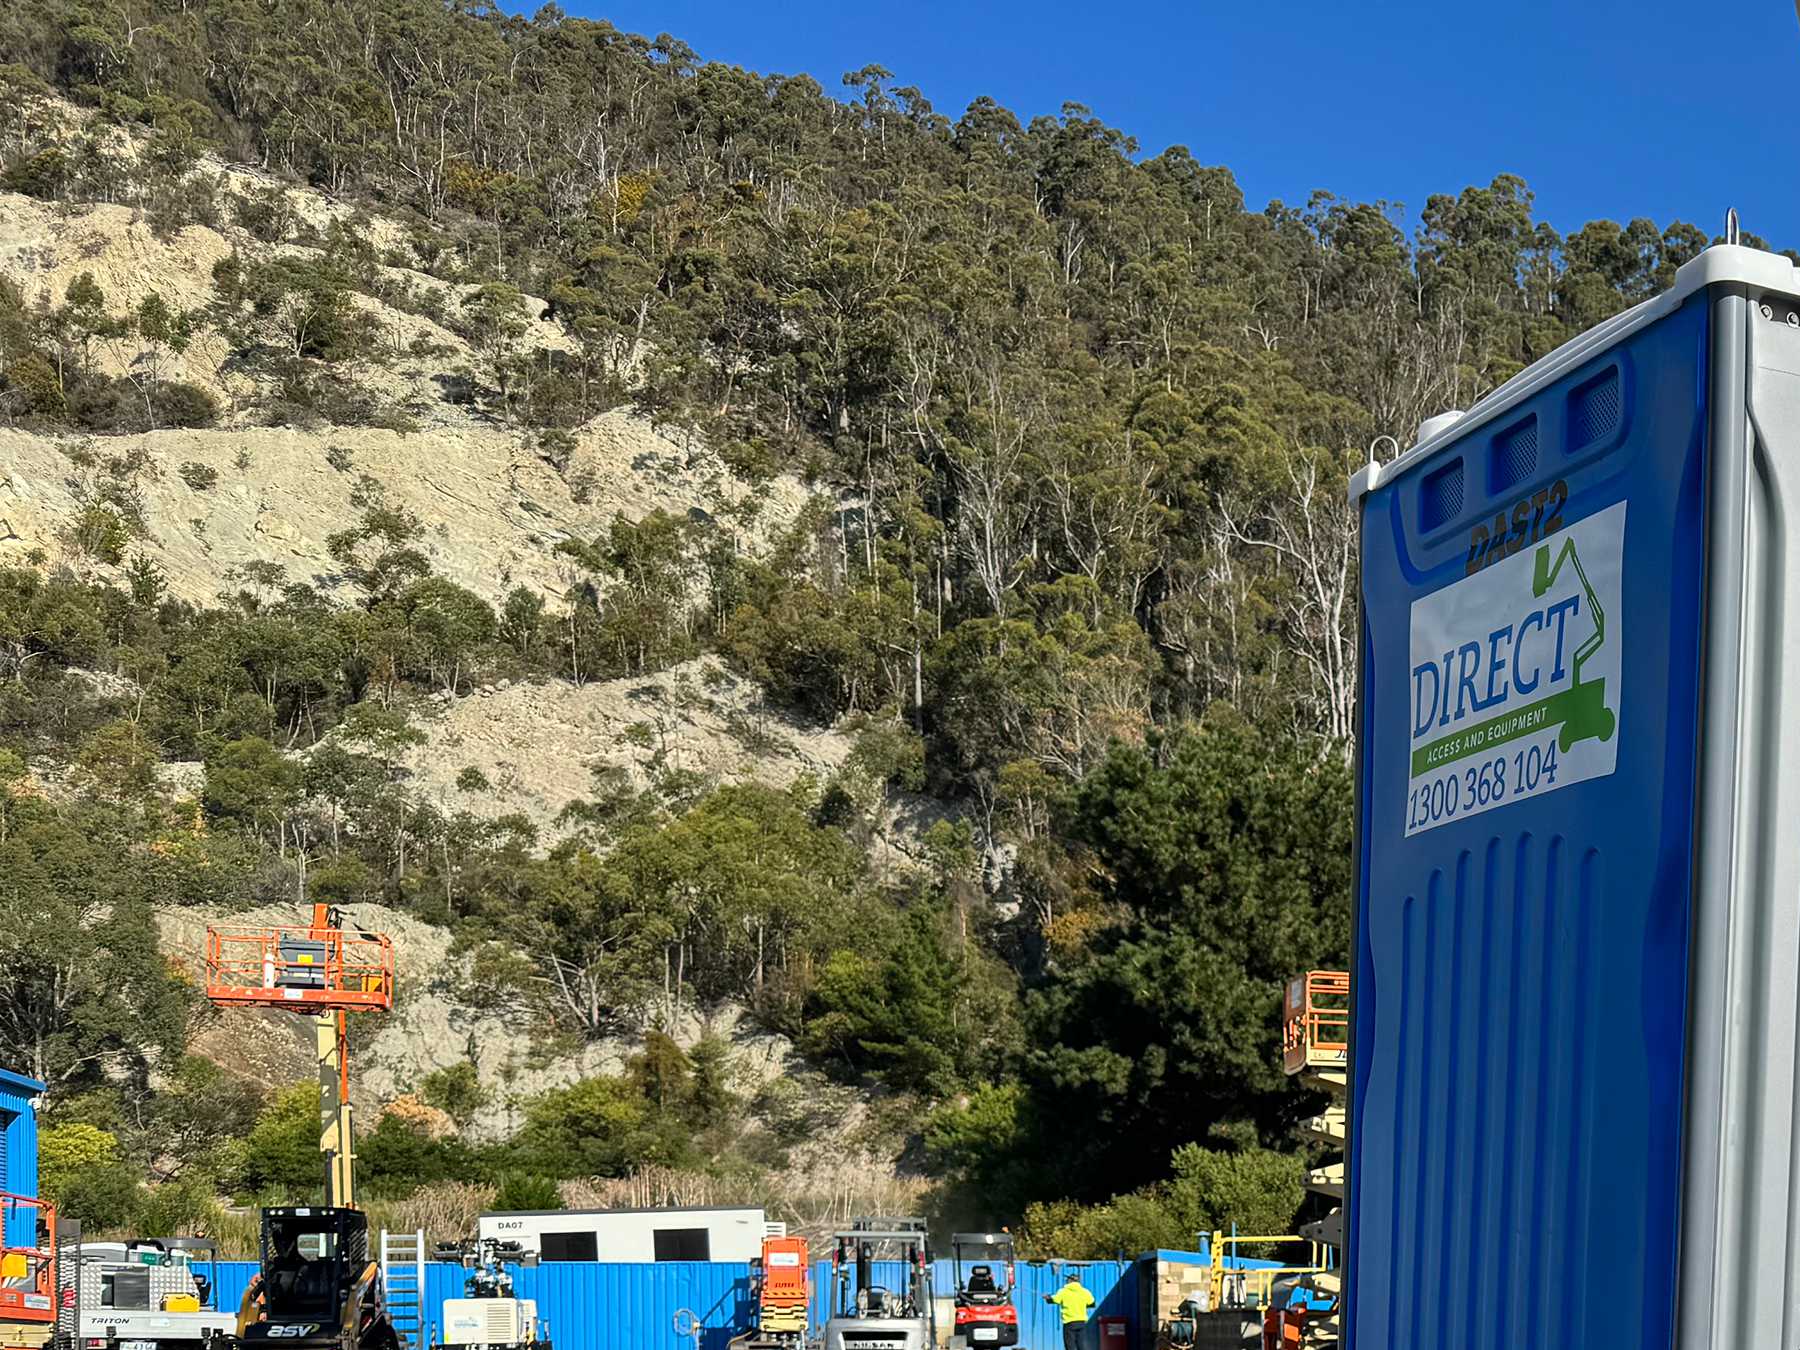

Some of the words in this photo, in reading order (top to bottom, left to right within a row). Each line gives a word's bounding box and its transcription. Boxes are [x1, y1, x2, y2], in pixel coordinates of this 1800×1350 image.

[1465, 480, 1568, 575] DAST2
[1413, 595, 1580, 739] DIRECT
[1426, 741, 1461, 763] ACCESS
[1463, 729, 1485, 752] AND
[1487, 706, 1548, 743] EQUIPMENT
[1408, 774, 1459, 831] 1300
[1463, 758, 1505, 811] 368
[1514, 739, 1558, 796] 104
[91, 1317, 130, 1325] TRITON
[266, 1324, 313, 1339] asv
